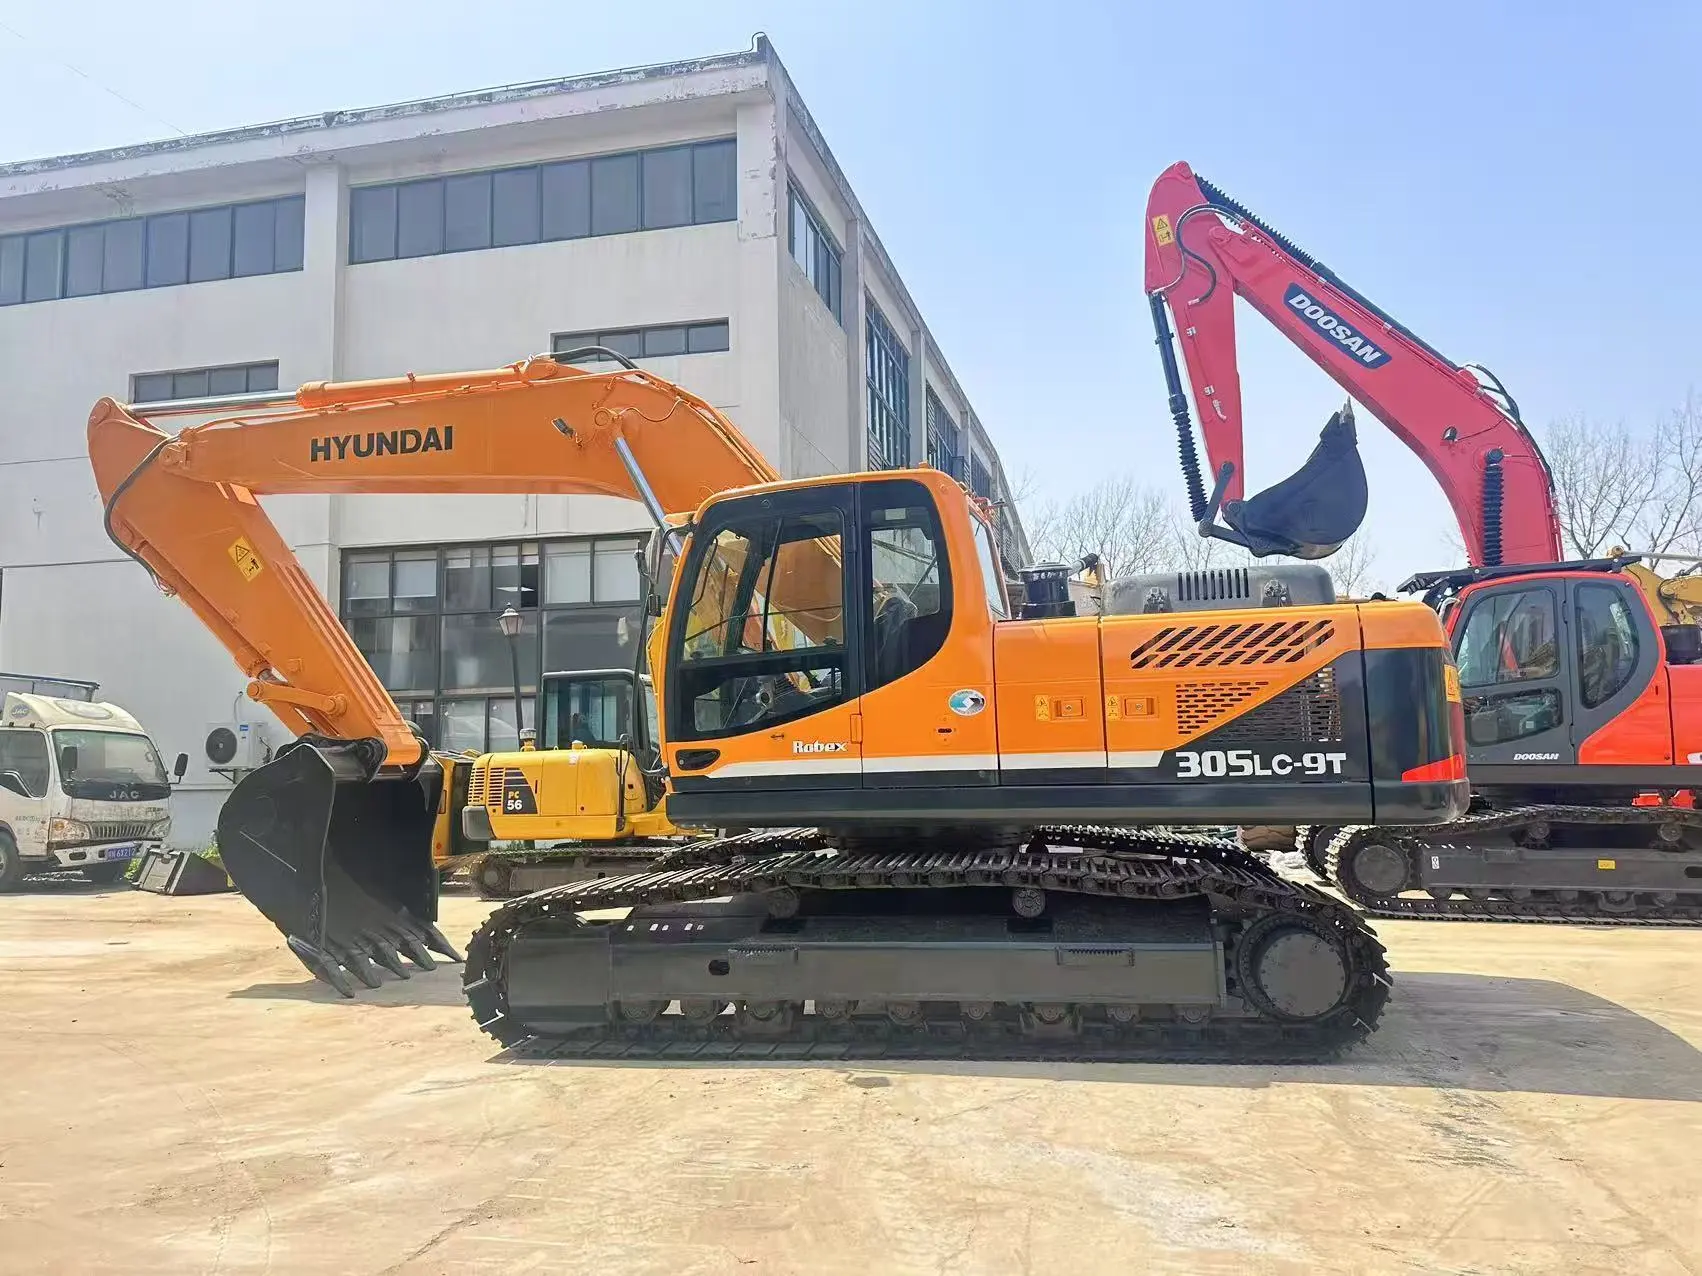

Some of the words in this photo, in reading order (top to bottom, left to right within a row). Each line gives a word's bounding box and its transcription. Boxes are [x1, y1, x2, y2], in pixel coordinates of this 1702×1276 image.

[1288, 293, 1382, 363] DOOSAN
[310, 425, 453, 462] HYUNDAI
[1513, 753, 1560, 761] DOOSAN
[1176, 750, 1347, 778] 305LC-9T
[109, 790, 140, 799] JAC
[508, 790, 520, 799] PC
[506, 799, 523, 811] 56
